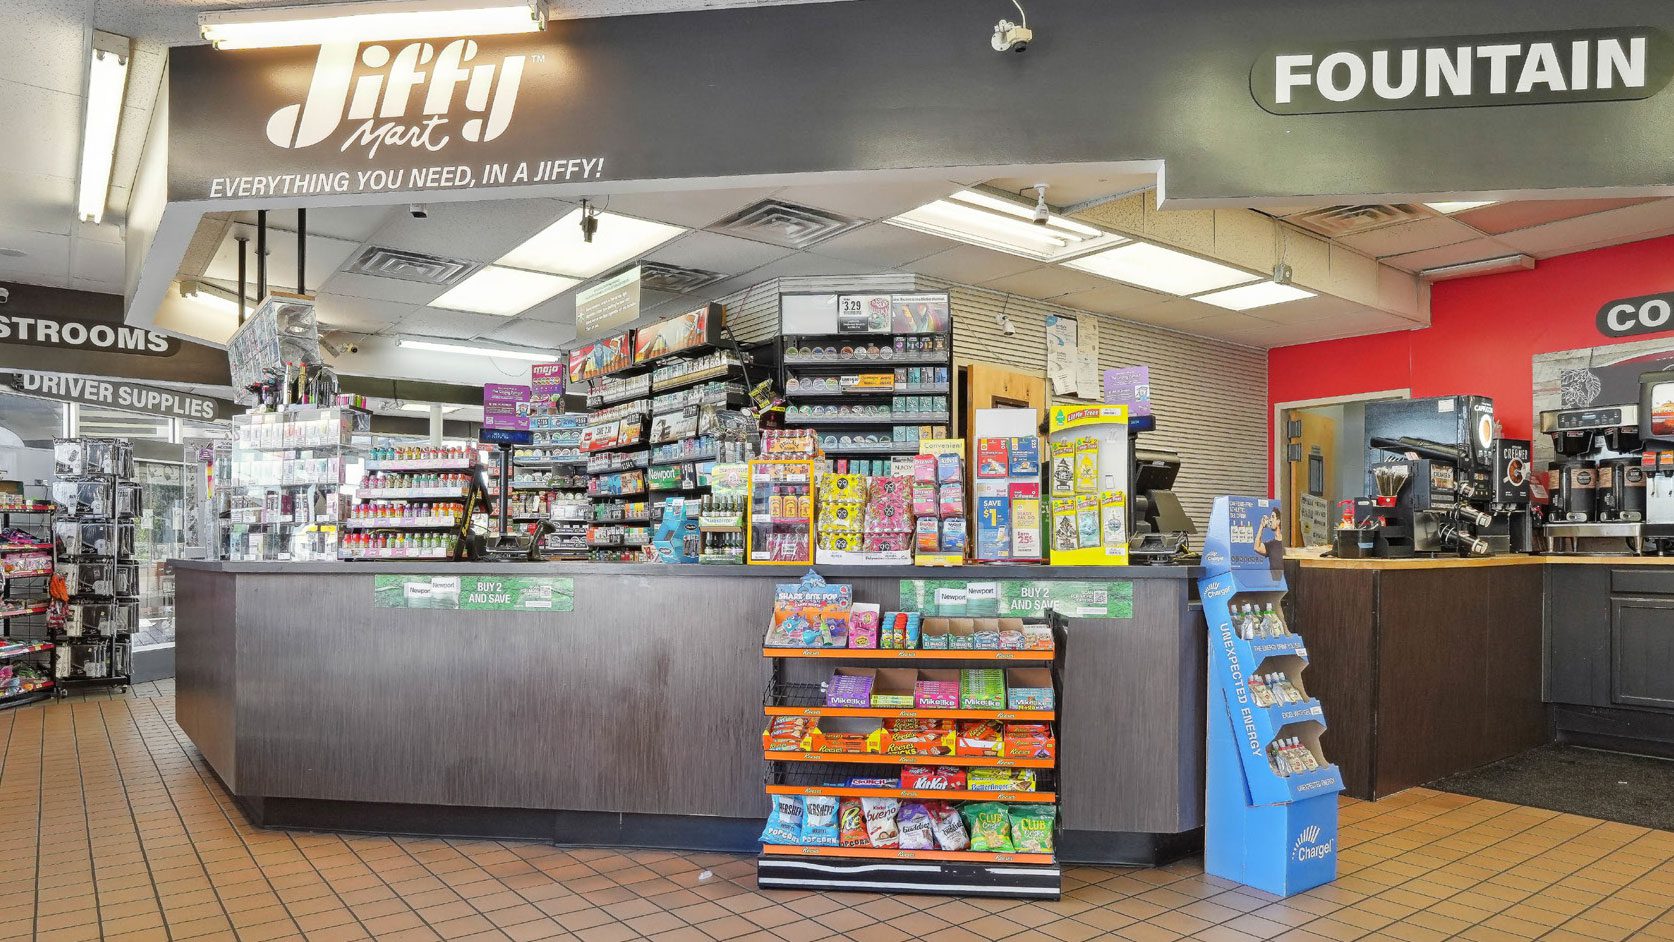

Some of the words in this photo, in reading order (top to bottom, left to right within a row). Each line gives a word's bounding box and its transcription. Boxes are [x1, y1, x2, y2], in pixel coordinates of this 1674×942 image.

[1275, 37, 1646, 104] FOUNTAIN
[266, 39, 525, 149] Jiffy
[341, 115, 450, 159] Mart
[209, 172, 349, 198] EVERYTHING
[357, 169, 403, 190] YOU
[409, 165, 476, 188] NEED,
[482, 164, 508, 184] IN
[512, 163, 528, 182] A
[533, 157, 604, 182] JIFFY!
[844, 301, 861, 311] 3.29
[1607, 299, 1671, 332] CO
[534, 365, 559, 376] mojo
[23, 374, 114, 403] DRIVER
[118, 386, 215, 419] SUPPLIES
[1503, 448, 1528, 459] CREAMER
[649, 468, 675, 481] Newport
[409, 587, 430, 595] Newpor
[432, 582, 455, 590] Newport
[477, 582, 495, 592] BUY
[496, 582, 502, 592] 2
[968, 587, 994, 596] Newport
[941, 593, 966, 601] Newport
[1021, 588, 1042, 597] BUY
[1043, 588, 1050, 597] 2
[468, 594, 488, 603] AND
[489, 594, 511, 603] SAVE
[1010, 600, 1033, 610] AND
[1034, 600, 1060, 610] SAVE
[1220, 622, 1248, 704] UNEXPECTED
[1241, 707, 1262, 757] ENERGY
[866, 807, 896, 821] bueno
[979, 812, 1002, 824] CLUB
[1021, 818, 1046, 830] CLUB
[802, 835, 837, 843] POPCORN
[1298, 841, 1332, 861] Chargel
